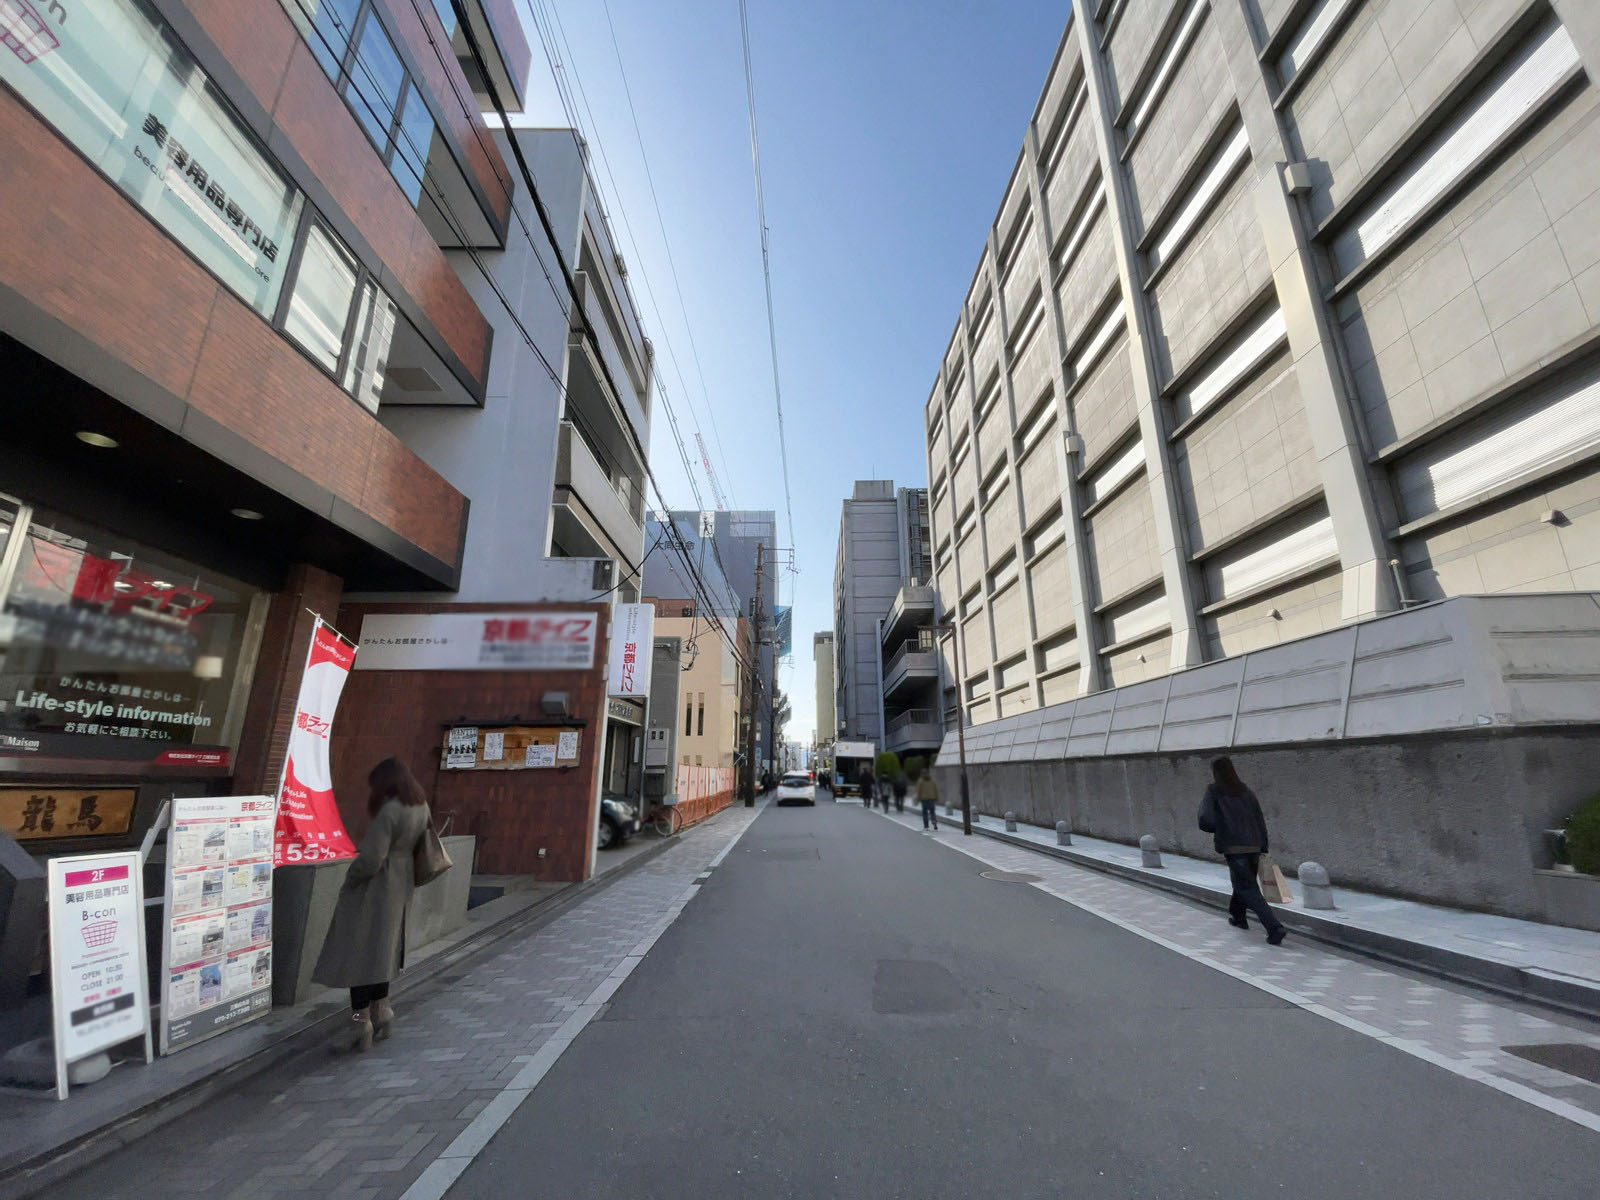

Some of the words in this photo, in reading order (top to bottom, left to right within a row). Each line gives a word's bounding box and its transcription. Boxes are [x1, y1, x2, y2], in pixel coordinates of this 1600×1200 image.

[142, 113, 279, 263] 美容用品専門店
[622, 642, 637, 693] 京都ライフ
[15, 690, 114, 718] Life-style
[116, 704, 212, 727] information
[18, 795, 103, 832] 龍馬
[287, 842, 337, 862] 55%
[91, 870, 105, 883] 2F
[65, 884, 129, 904] 美容用品専門店
[82, 907, 117, 921] B-con
